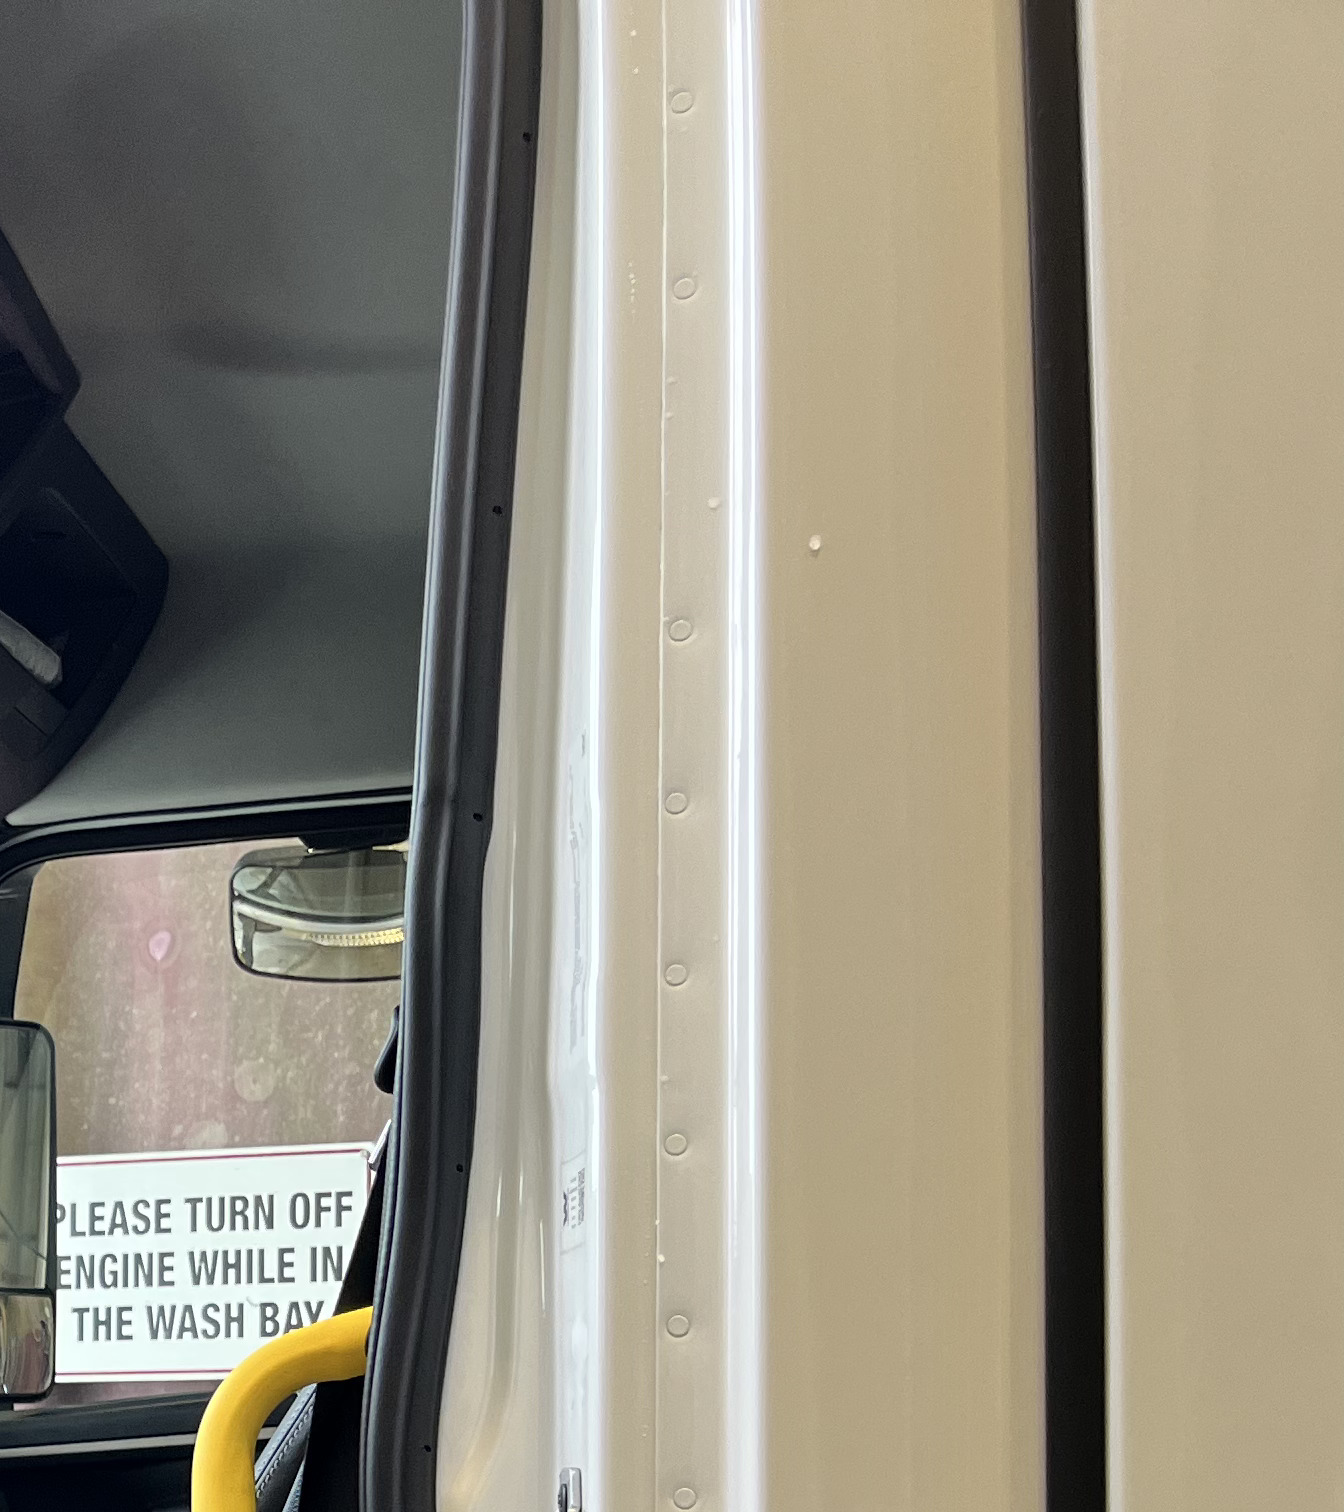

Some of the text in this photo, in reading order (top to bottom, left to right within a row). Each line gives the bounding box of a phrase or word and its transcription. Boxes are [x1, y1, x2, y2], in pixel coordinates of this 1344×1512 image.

[184, 1194, 275, 1232] TURN
[289, 1191, 353, 1230] OFF
[57, 1245, 344, 1290] ENGINE WHILE IN
[71, 1300, 325, 1342] THE WASH BAY
